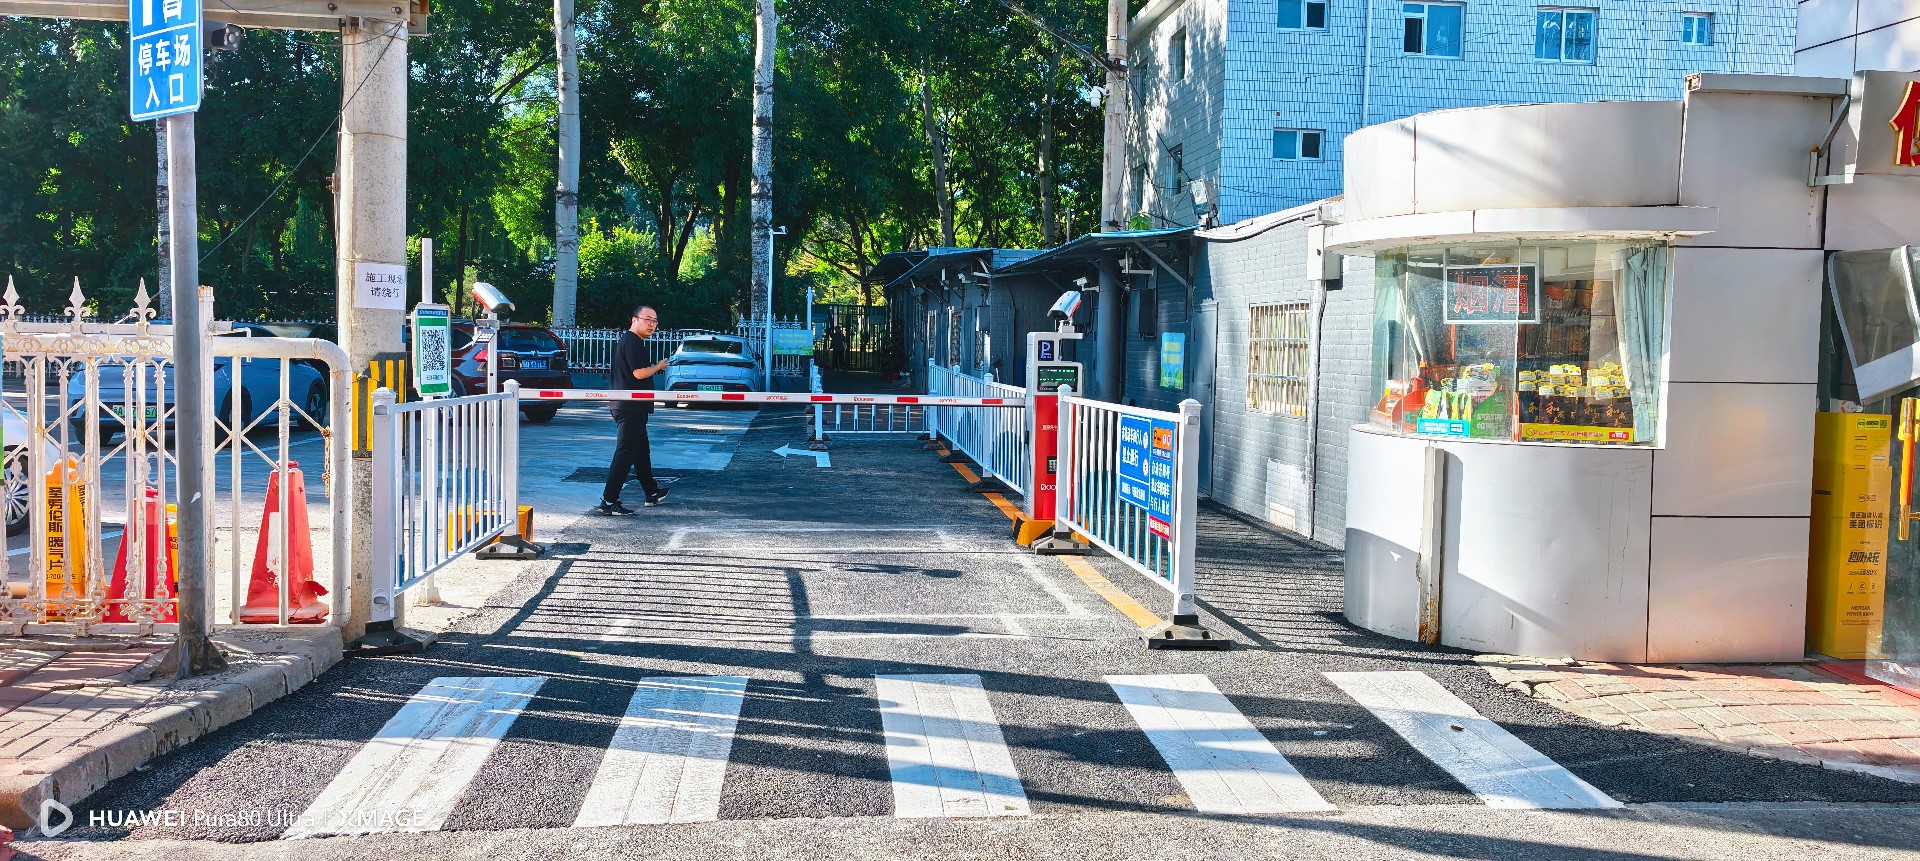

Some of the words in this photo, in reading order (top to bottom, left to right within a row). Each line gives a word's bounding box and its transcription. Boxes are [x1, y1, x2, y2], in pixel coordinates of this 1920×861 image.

[138, 34, 191, 76] 停车场
[145, 73, 184, 109] 入口
[370, 286, 400, 298] 请绕行
[1452, 274, 1529, 314] 烟酒
[1849, 519, 1883, 529] 美团标识
